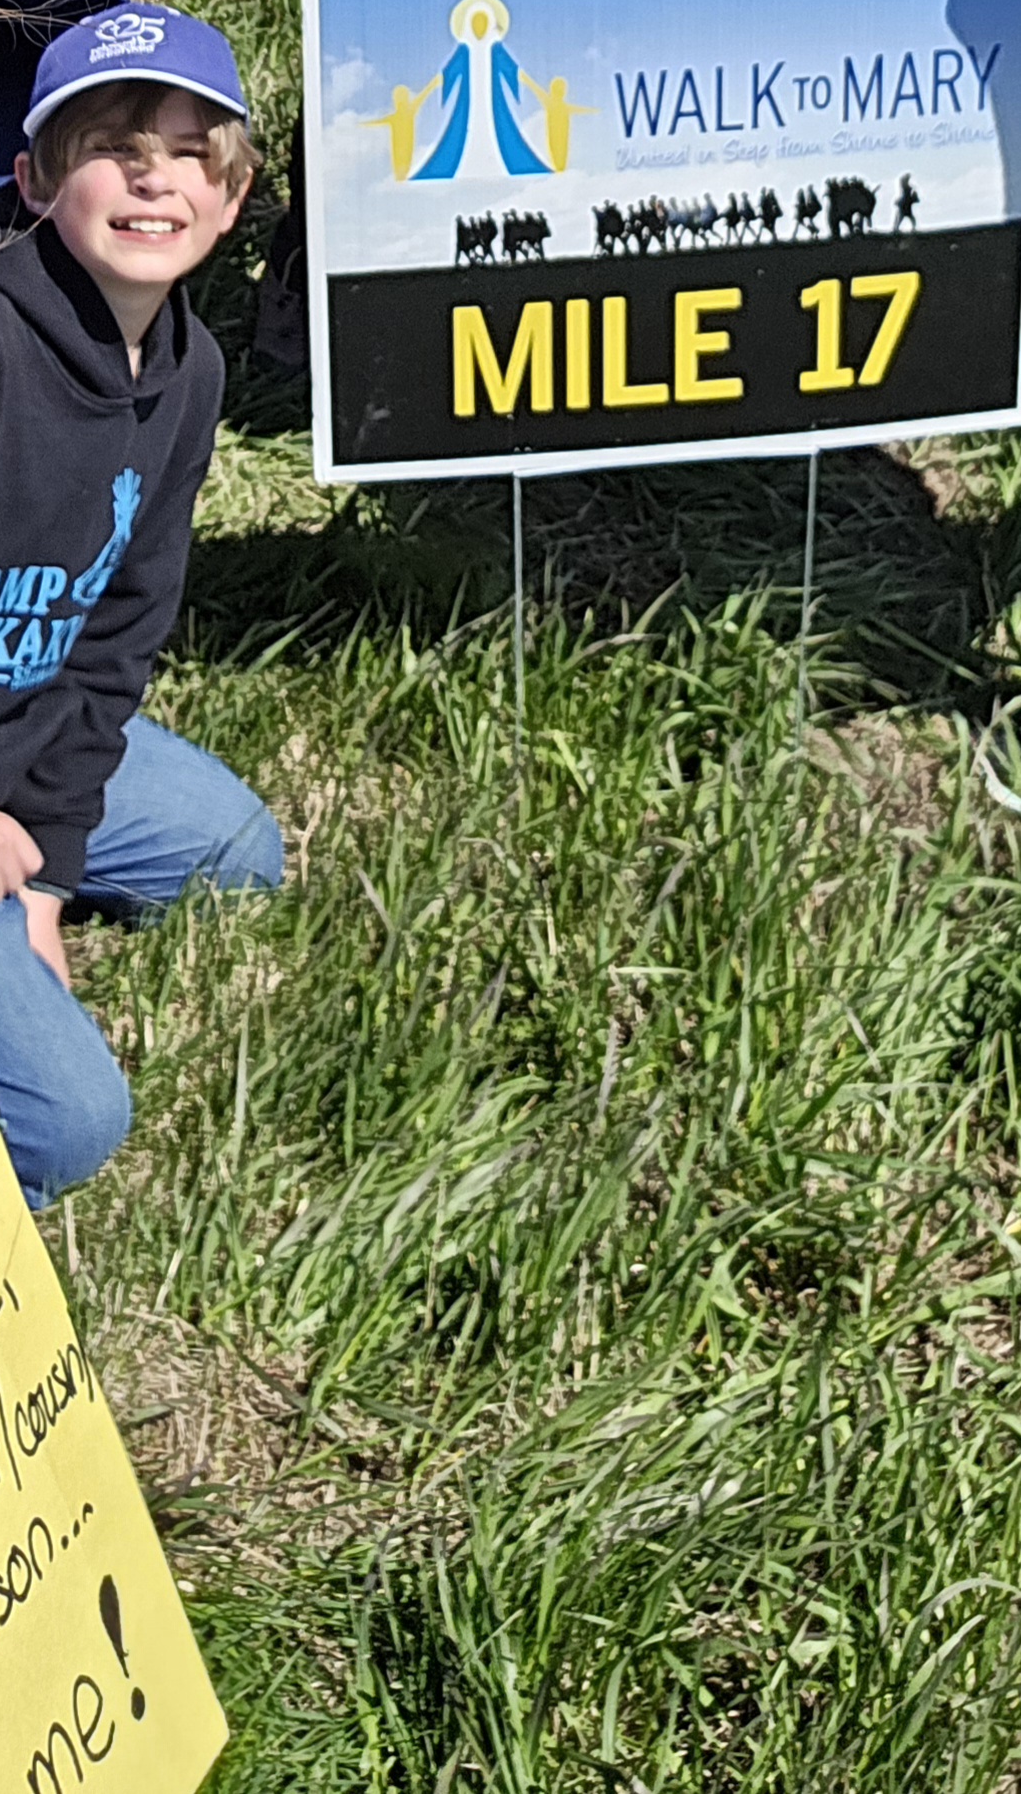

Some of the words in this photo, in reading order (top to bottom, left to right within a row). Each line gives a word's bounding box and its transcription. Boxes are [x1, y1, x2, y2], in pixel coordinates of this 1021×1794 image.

[614, 60, 787, 139] WALK
[792, 74, 833, 112] TO
[842, 42, 1002, 124] MARY
[451, 286, 744, 417] MILE
[799, 271, 921, 392] 17
